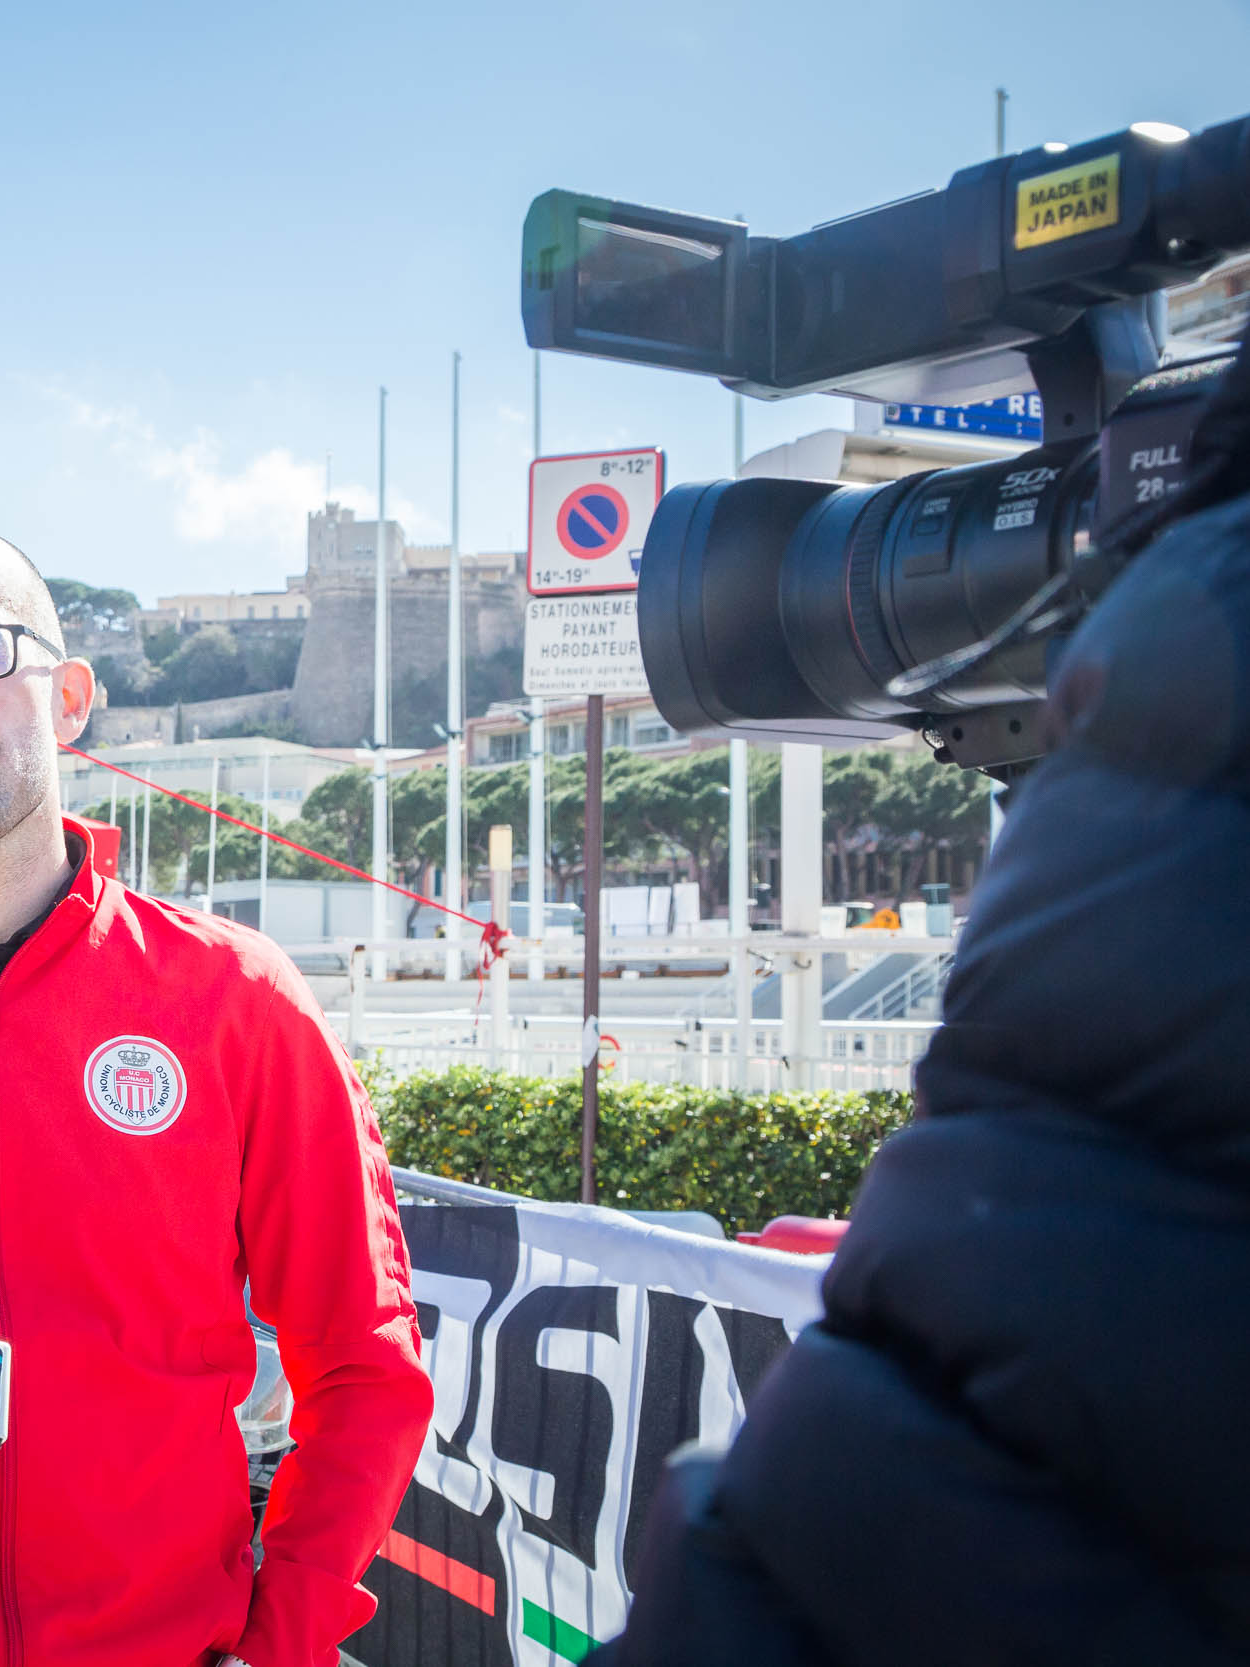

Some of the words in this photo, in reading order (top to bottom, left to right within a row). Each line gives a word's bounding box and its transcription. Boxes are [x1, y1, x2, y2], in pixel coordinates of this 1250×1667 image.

[1029, 178, 1083, 208] MADE
[1088, 170, 1109, 192] IN
[1027, 193, 1107, 232] JAPAN
[1129, 444, 1182, 472] FULL
[563, 621, 618, 637] PAYANT
[99, 1064, 113, 1092] UNION
[118, 1075, 150, 1083] MONACO
[155, 1065, 170, 1107] MONACO
[104, 1094, 147, 1119] CYCLISTE
[148, 1105, 161, 1117] DE
